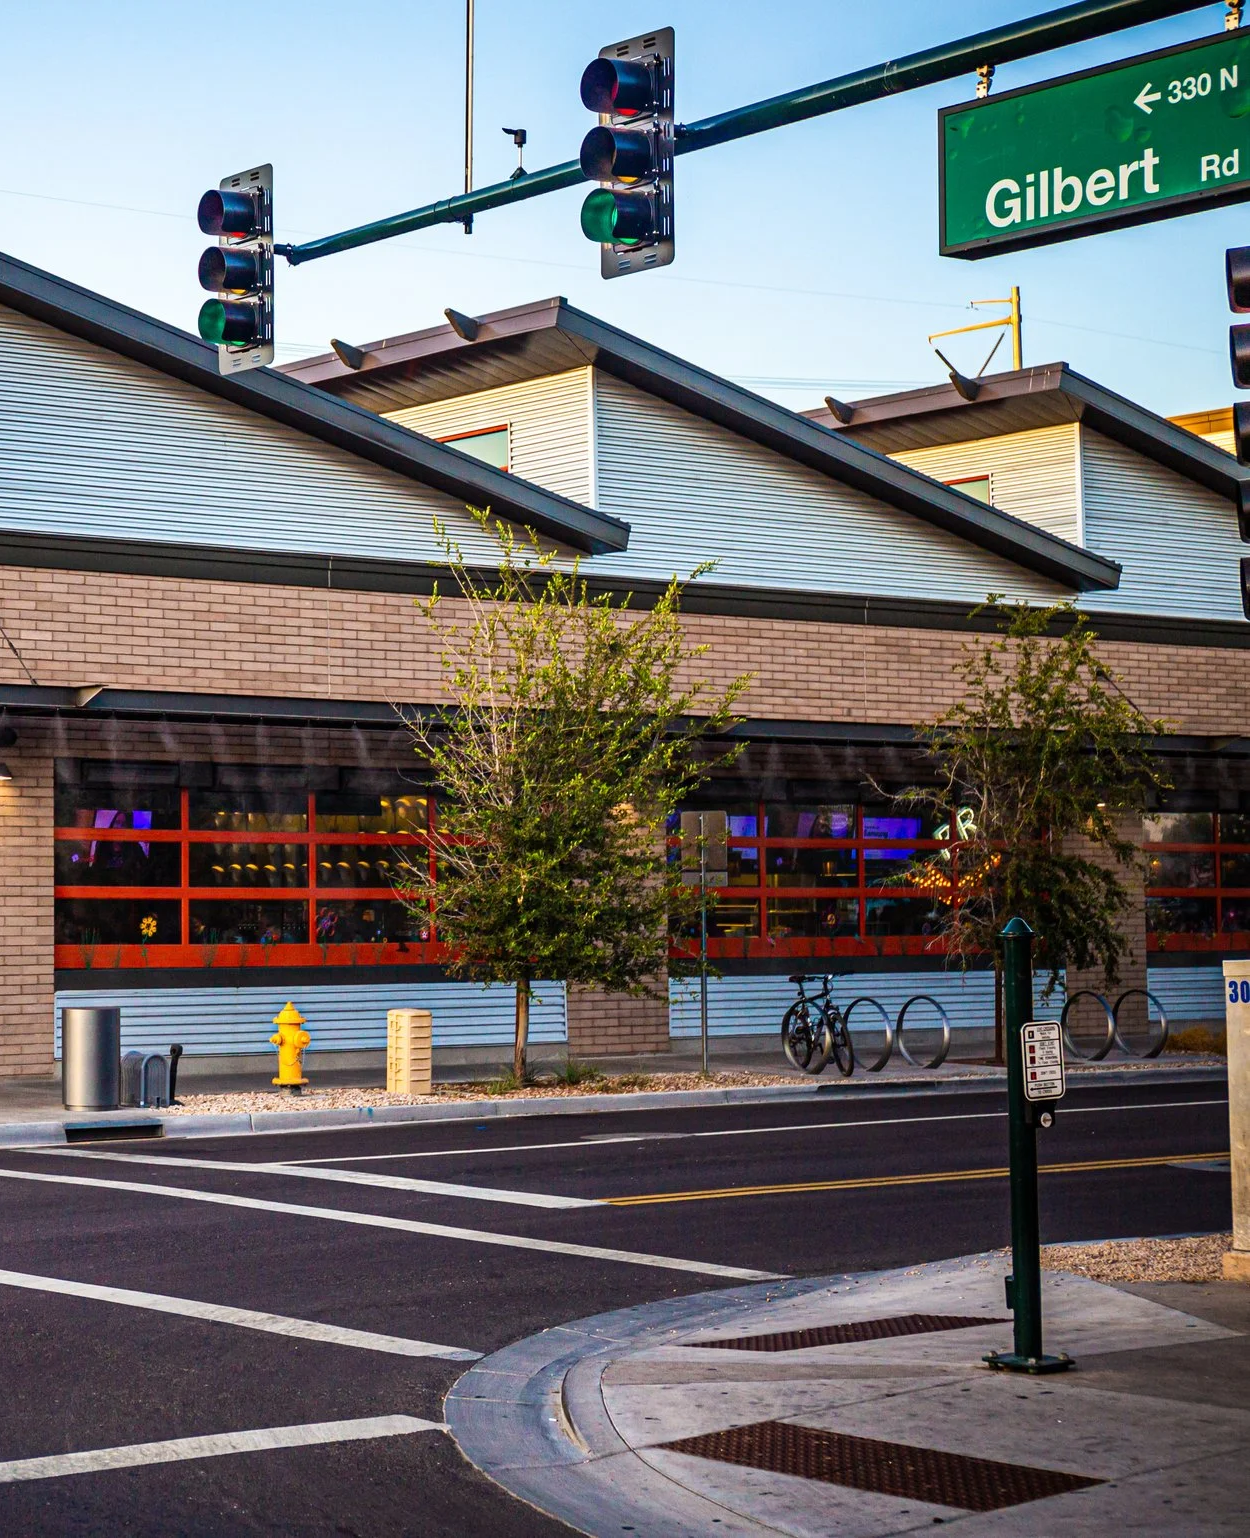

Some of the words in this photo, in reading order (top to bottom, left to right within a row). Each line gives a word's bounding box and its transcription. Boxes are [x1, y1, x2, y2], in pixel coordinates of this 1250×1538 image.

[1167, 73, 1211, 104] 330
[1220, 65, 1238, 91] N
[985, 147, 1160, 228] Gilbert
[1201, 149, 1239, 182] Rd
[1228, 980, 1250, 1004] 30
